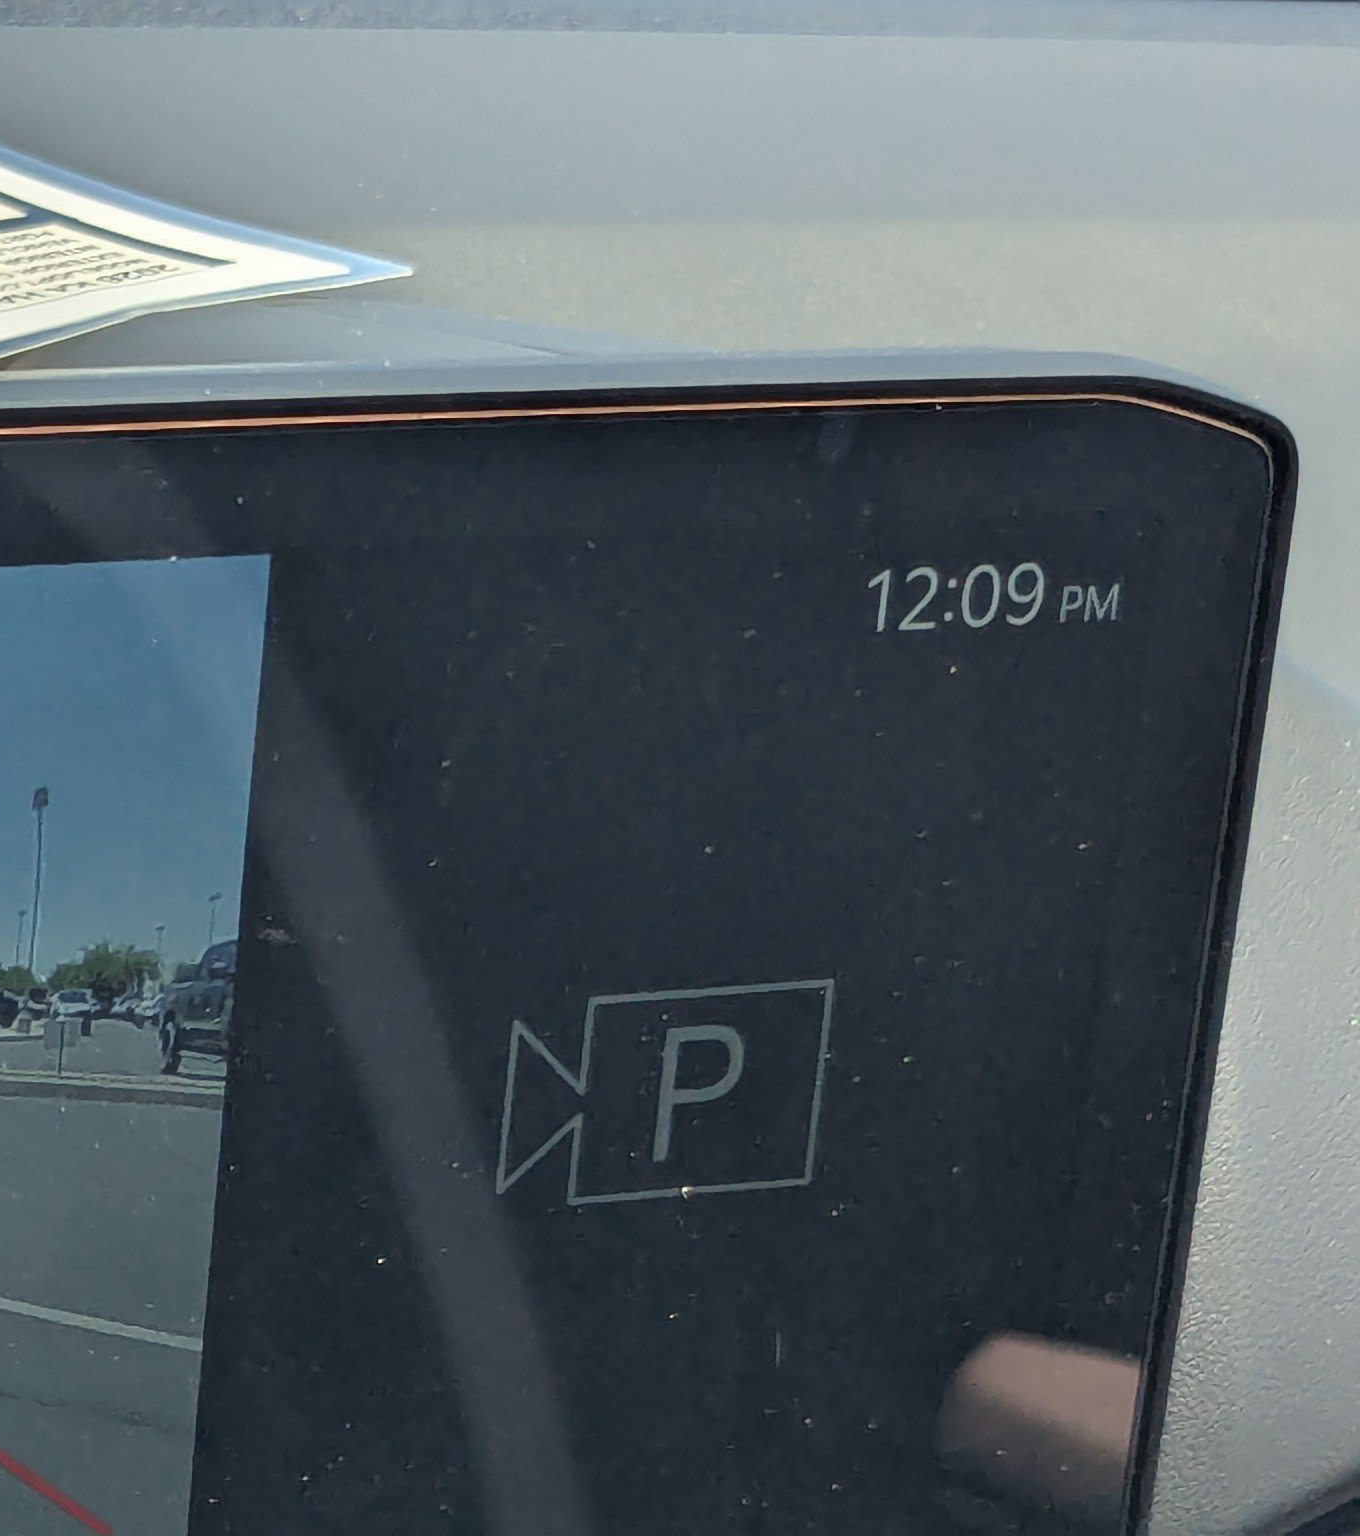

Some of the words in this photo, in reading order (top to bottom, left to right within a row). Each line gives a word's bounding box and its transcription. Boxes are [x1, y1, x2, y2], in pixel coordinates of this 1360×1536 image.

[867, 562, 1045, 632] 12:09
[1058, 581, 1121, 625] PM
[652, 1025, 744, 1163] P
